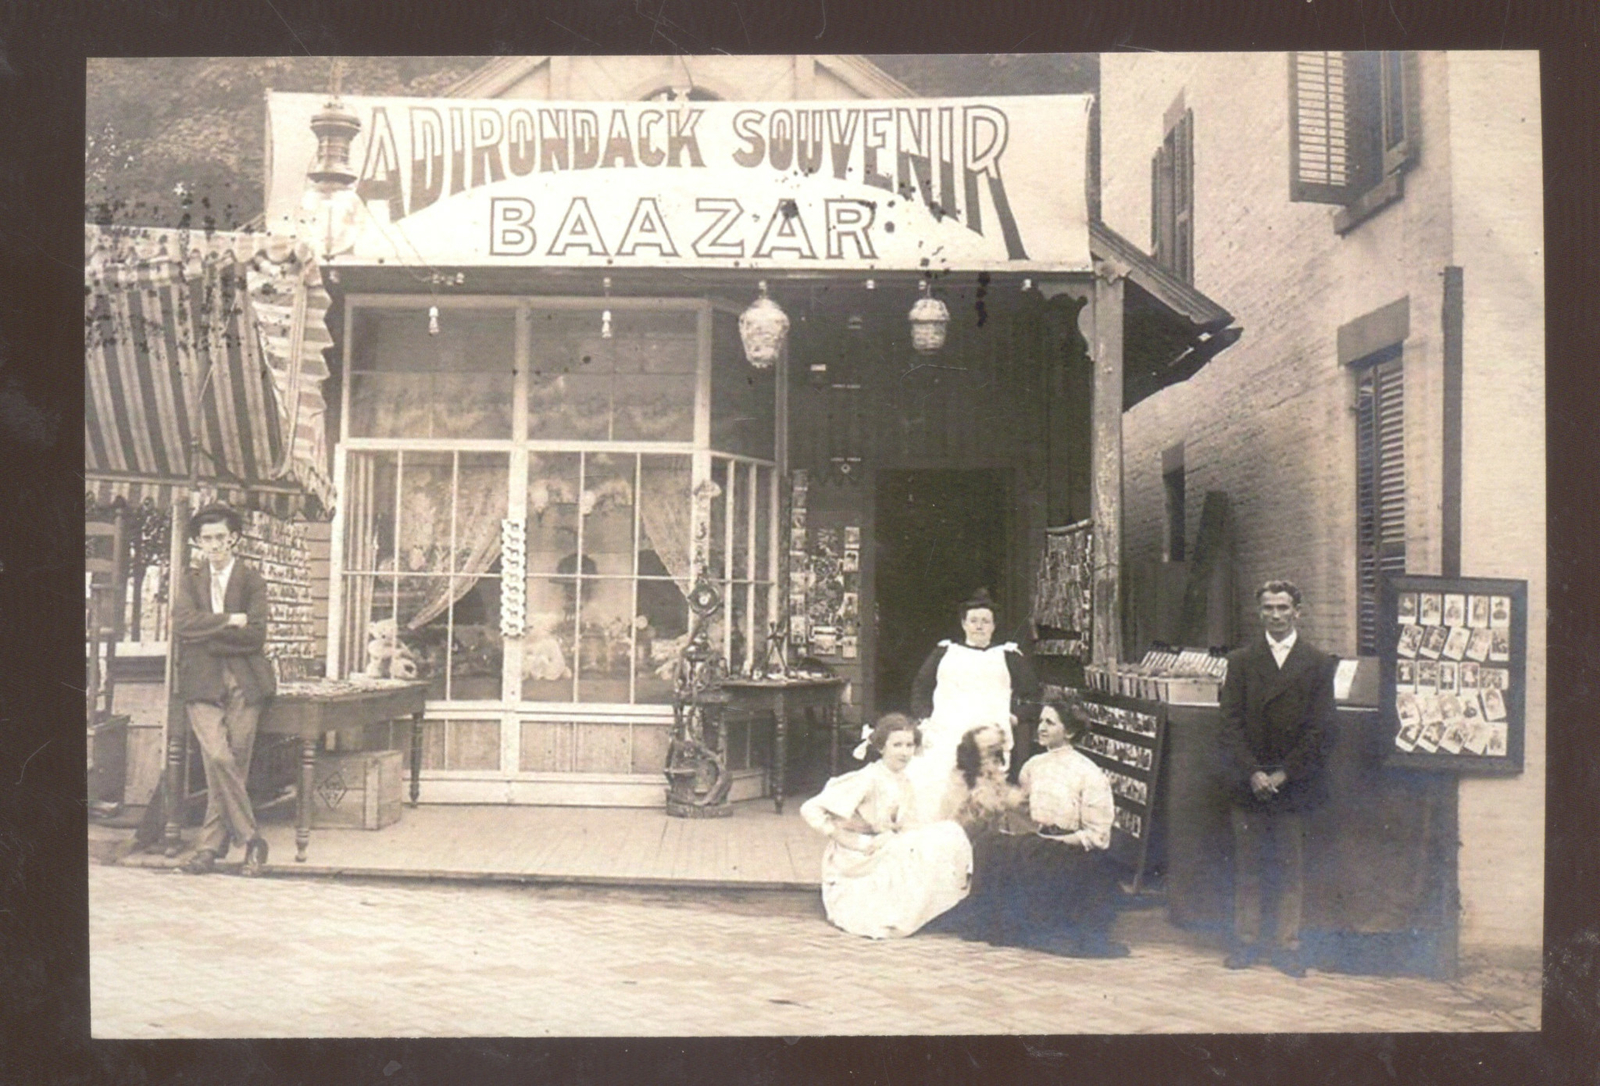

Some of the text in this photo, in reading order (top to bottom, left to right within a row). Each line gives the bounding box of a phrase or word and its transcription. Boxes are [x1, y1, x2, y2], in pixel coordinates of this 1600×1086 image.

[356, 104, 1031, 260] ADIRONDACK SOUVENIR
[489, 197, 879, 259] BAAZAR
